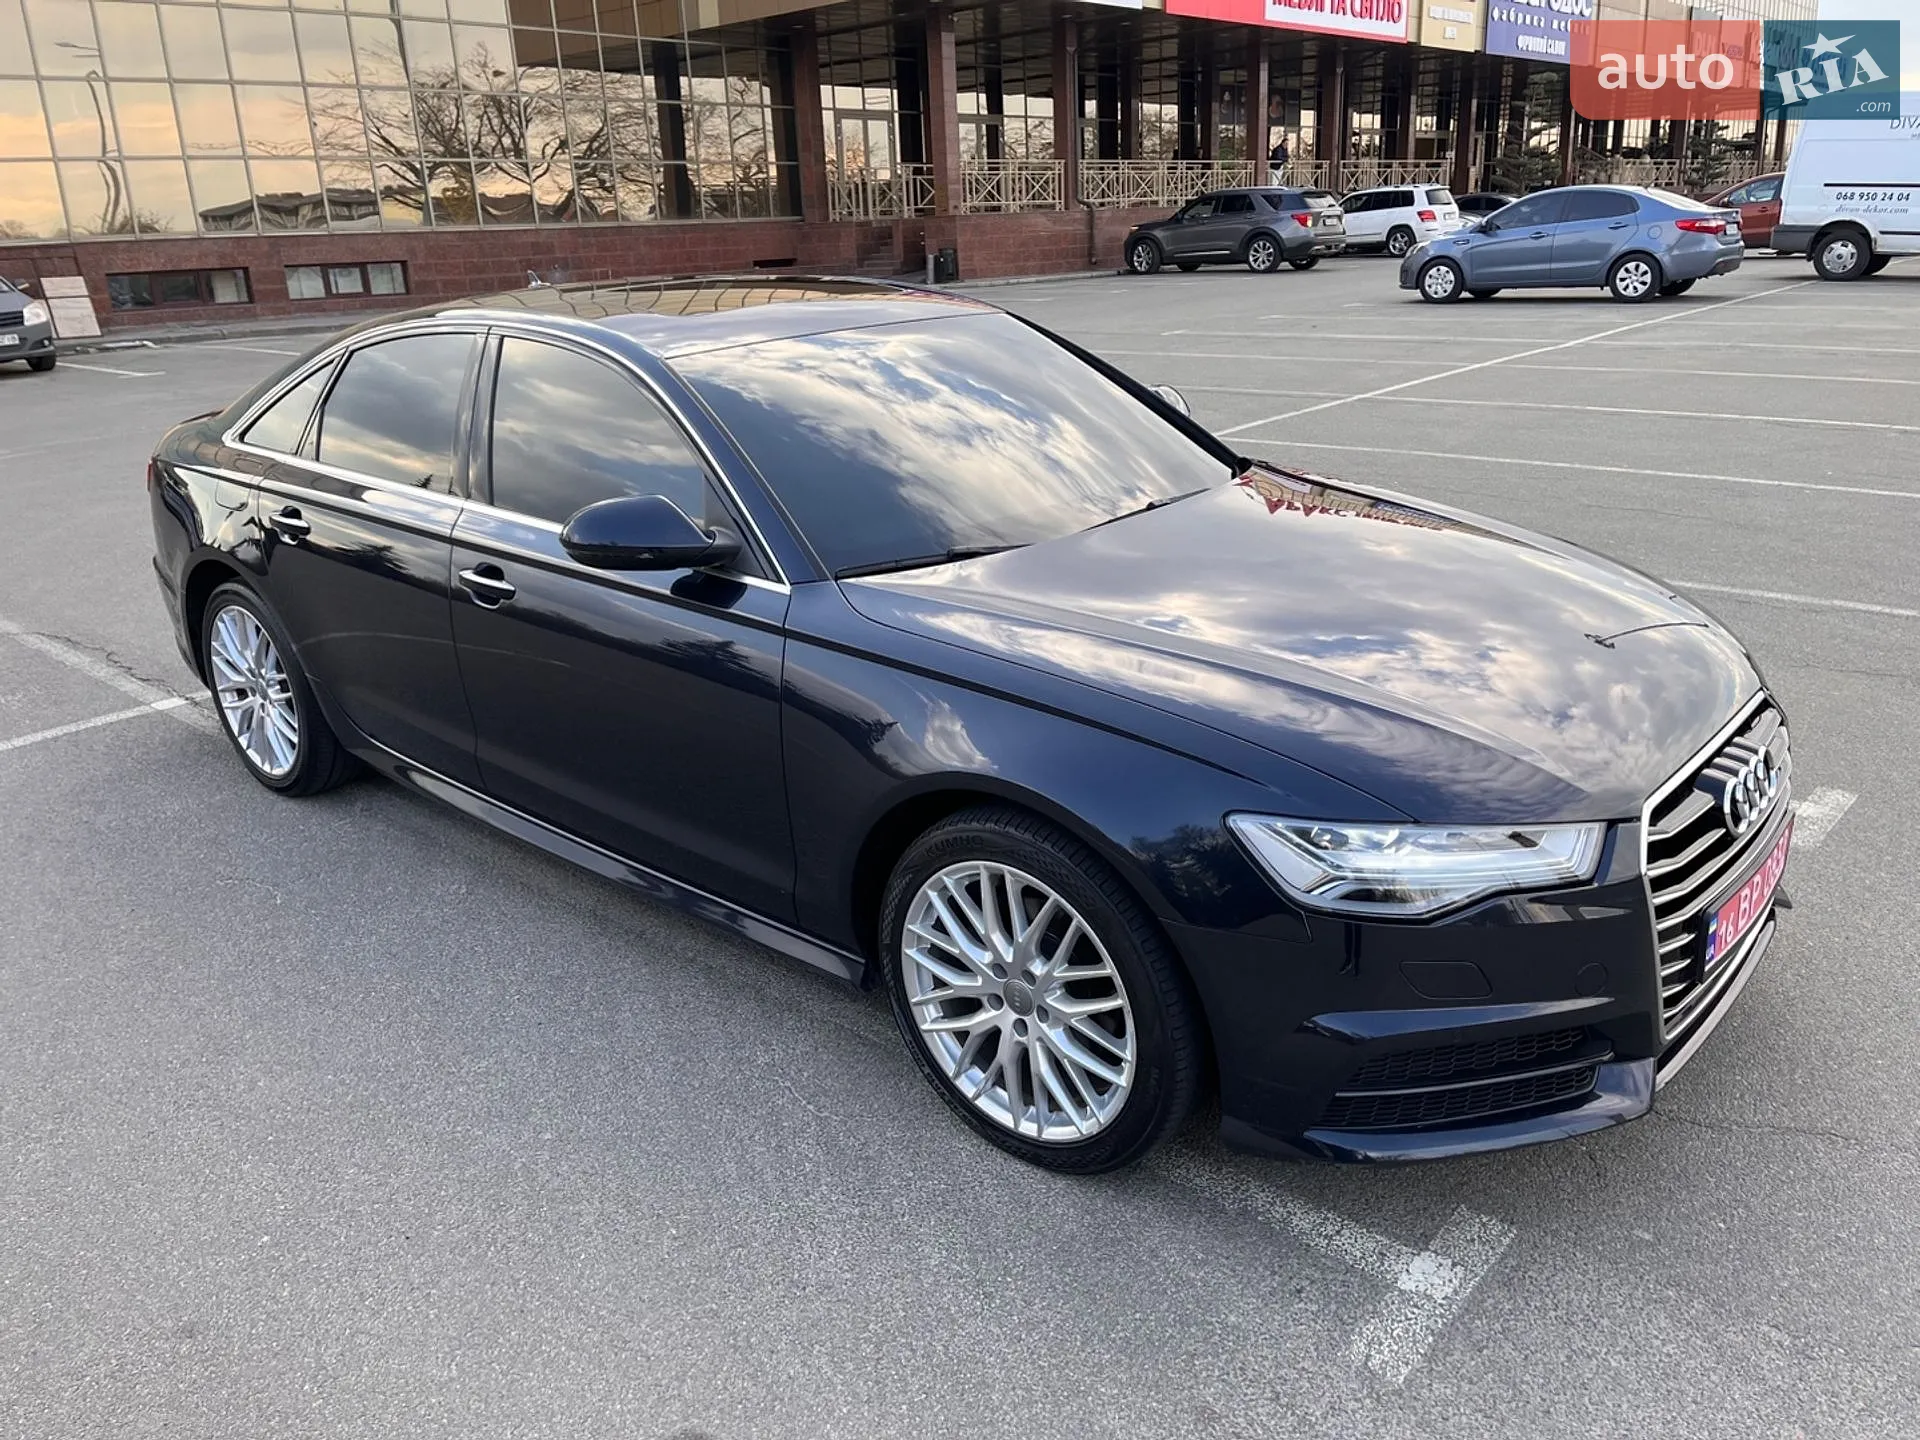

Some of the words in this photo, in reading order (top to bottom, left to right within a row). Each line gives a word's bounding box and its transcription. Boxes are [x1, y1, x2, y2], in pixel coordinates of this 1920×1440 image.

[1835, 192, 1855, 201] 068
[1858, 192, 1878, 201] 950
[1880, 192, 1894, 201] 24
[1897, 192, 1911, 201] 04
